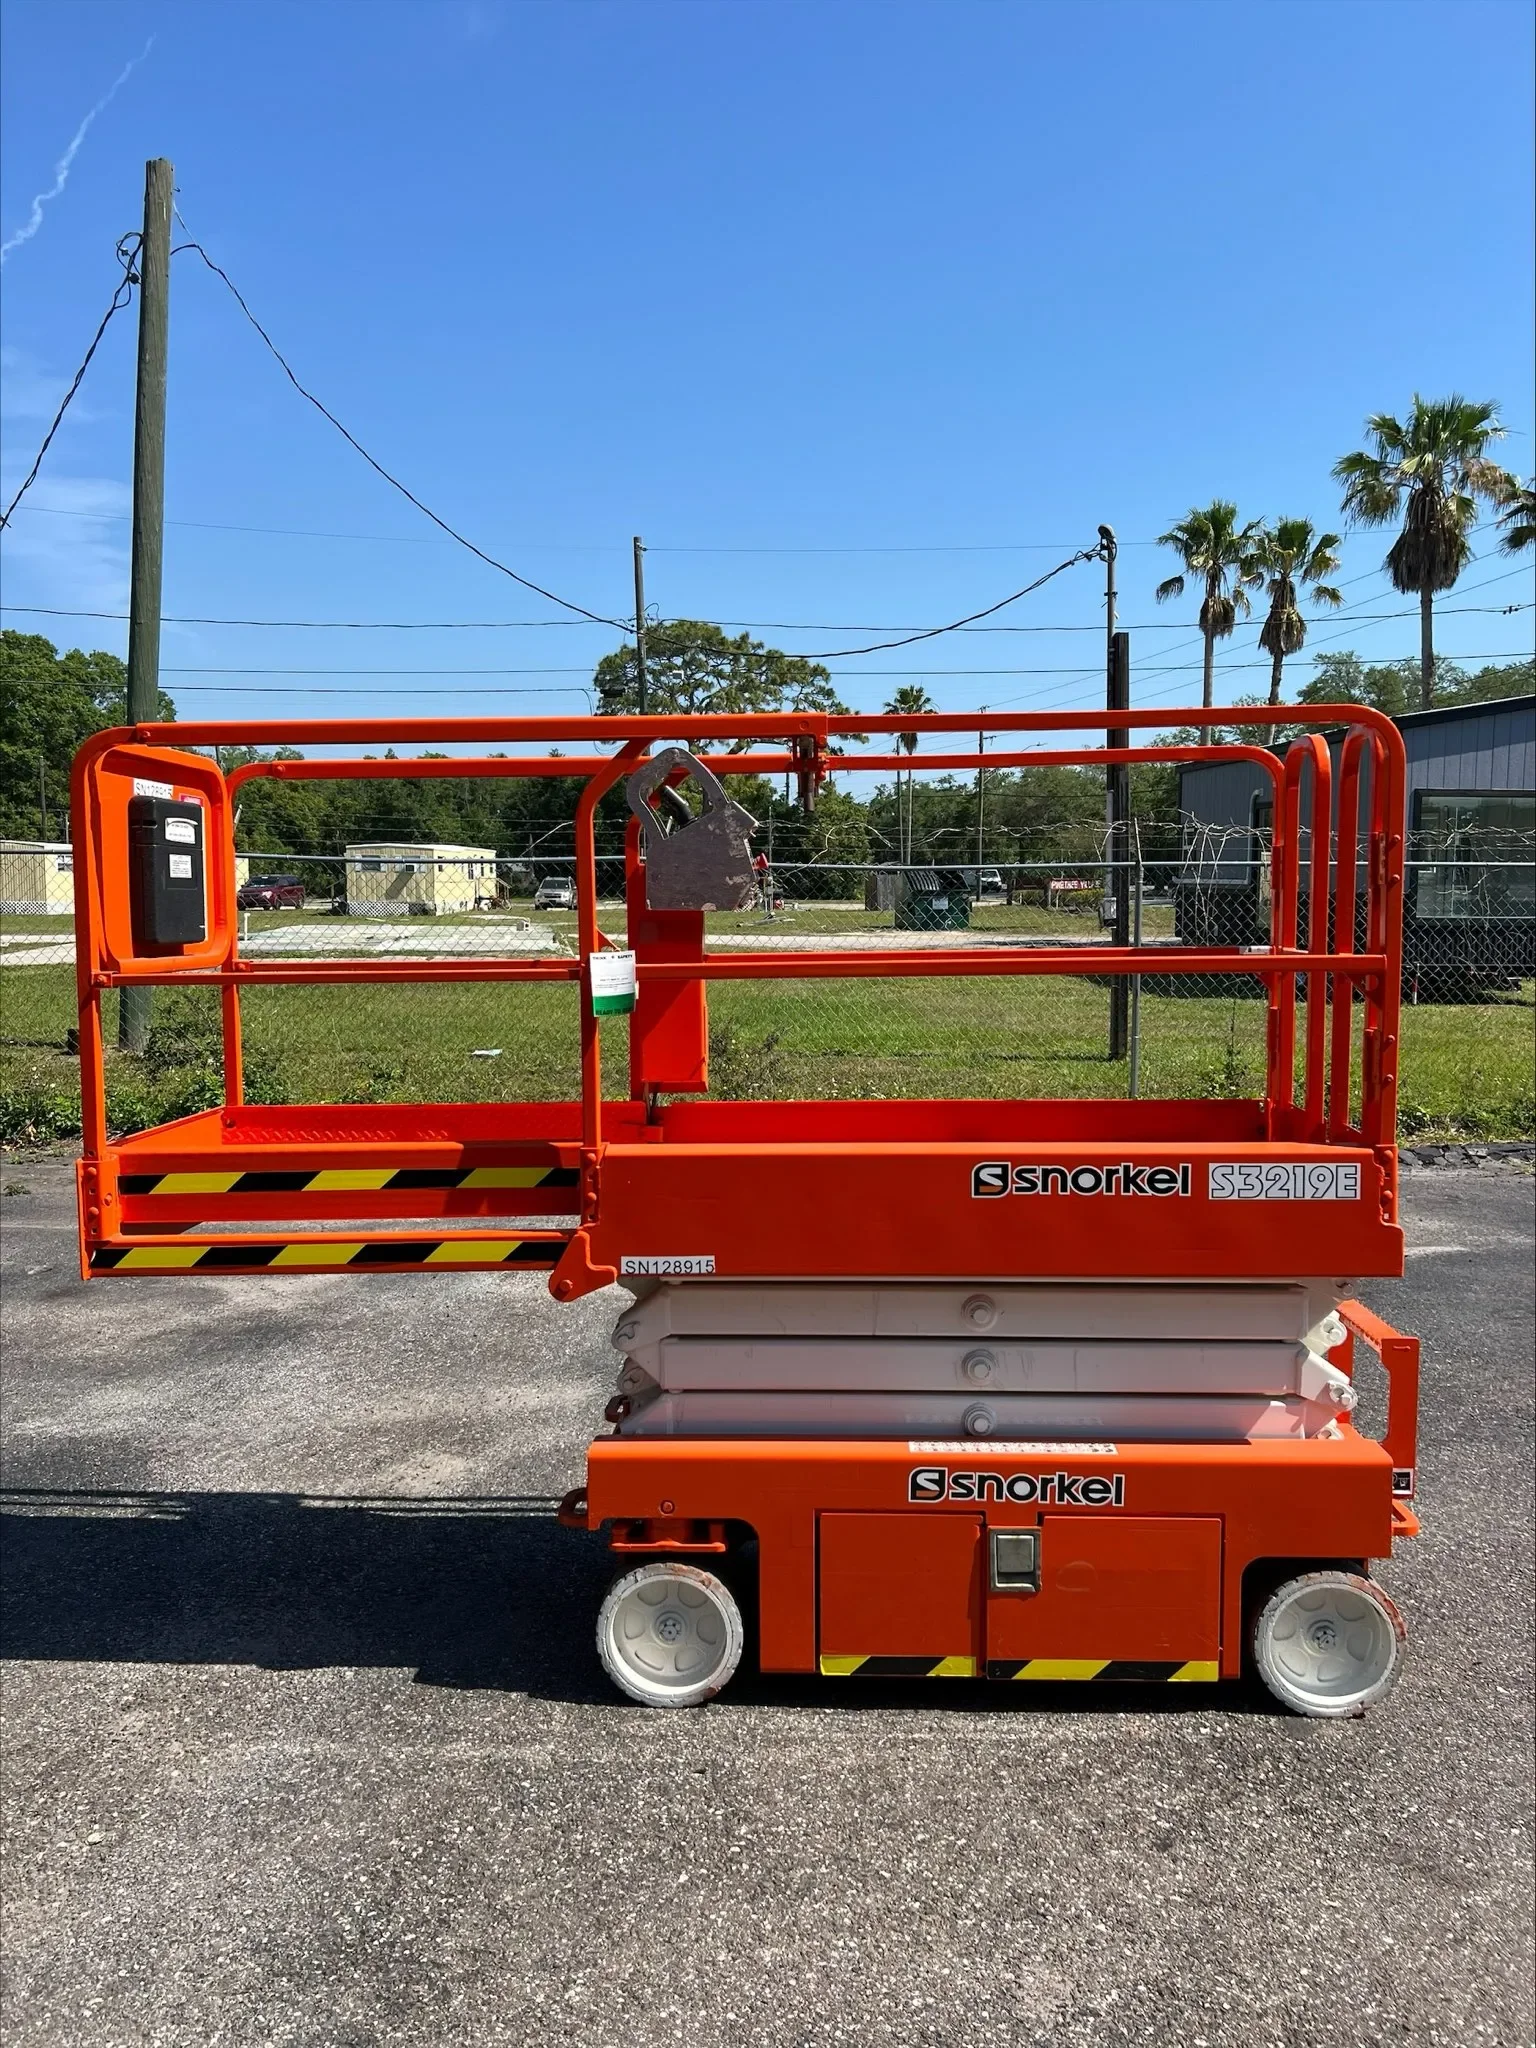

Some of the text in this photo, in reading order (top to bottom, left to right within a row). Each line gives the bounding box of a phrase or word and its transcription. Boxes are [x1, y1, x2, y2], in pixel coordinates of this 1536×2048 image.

[1012, 1163, 1191, 1197] snorkel
[1211, 1165, 1358, 1199] S3219E
[625, 1259, 715, 1274] SN128915
[949, 1472, 1125, 1506] snorkel
